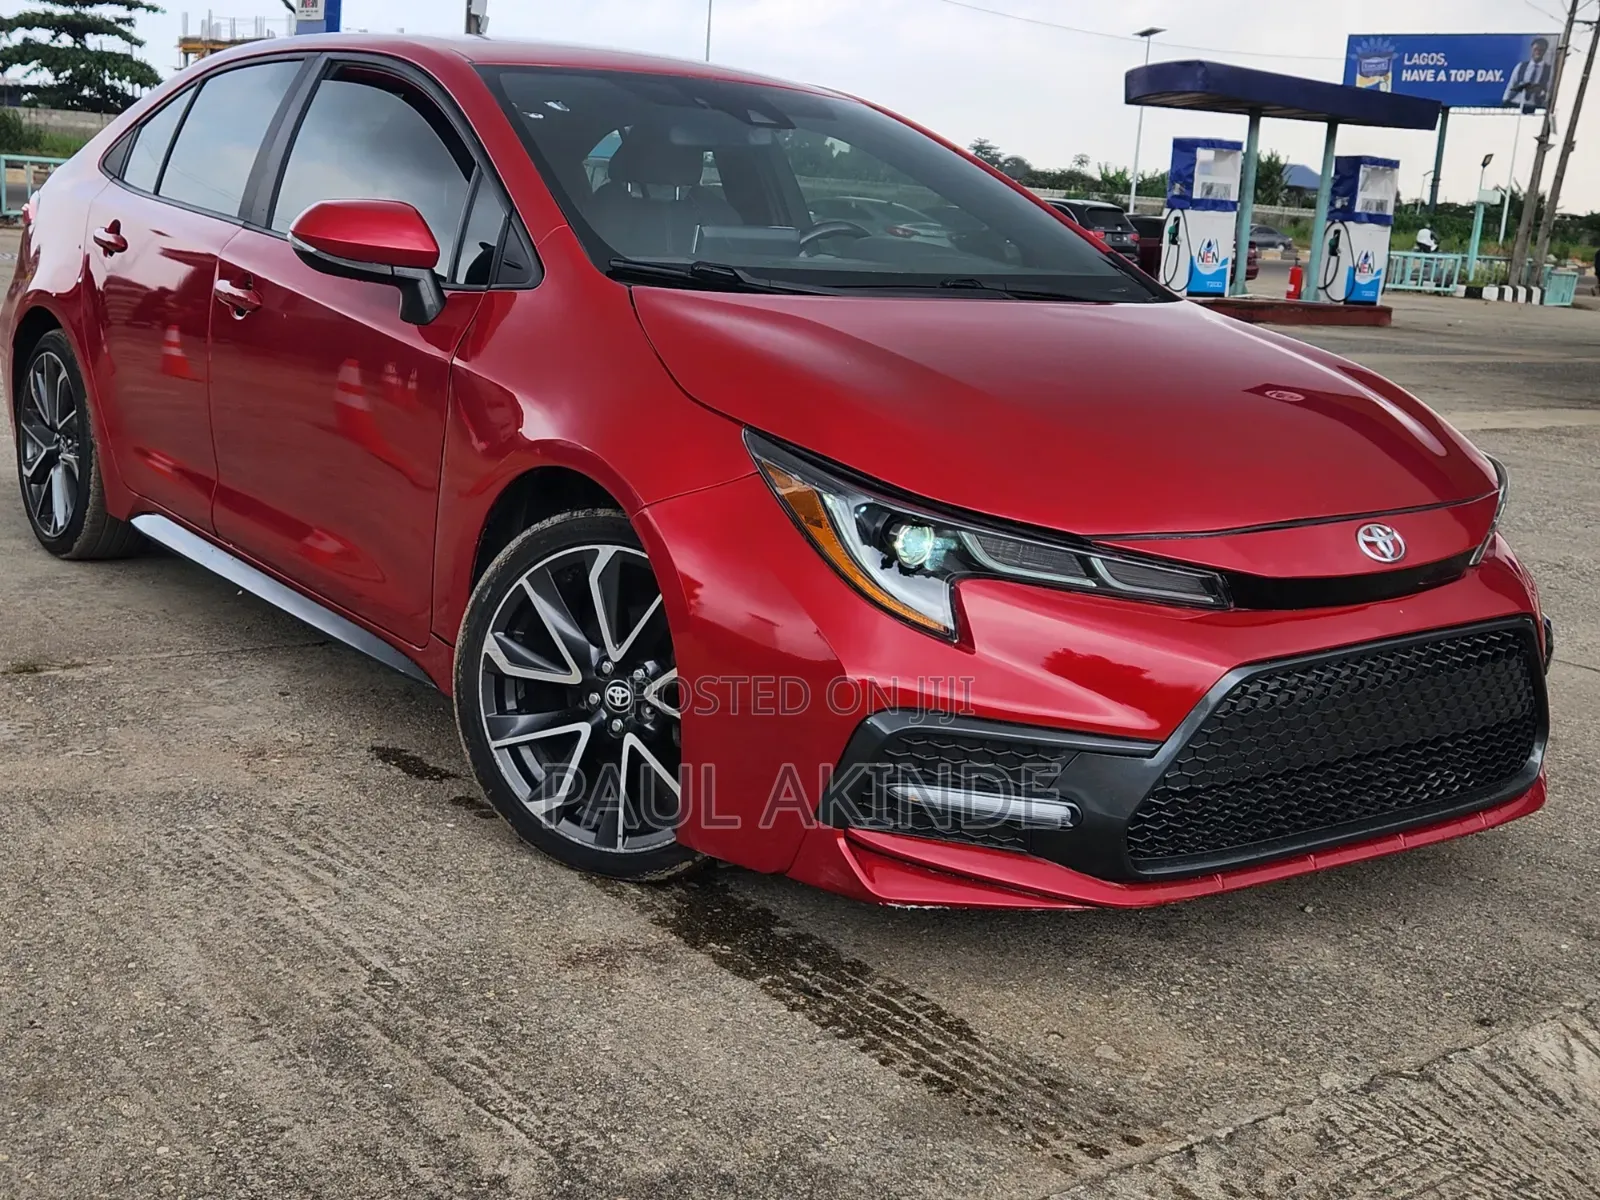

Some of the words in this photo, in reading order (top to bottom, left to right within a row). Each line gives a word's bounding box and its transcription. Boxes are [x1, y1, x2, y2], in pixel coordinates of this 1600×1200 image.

[1403, 52, 1448, 66] LAGOS,
[1402, 69, 1435, 82] HAVE
[1437, 70, 1447, 82] A
[1449, 70, 1475, 82] TOP
[1476, 70, 1505, 82] DAY.
